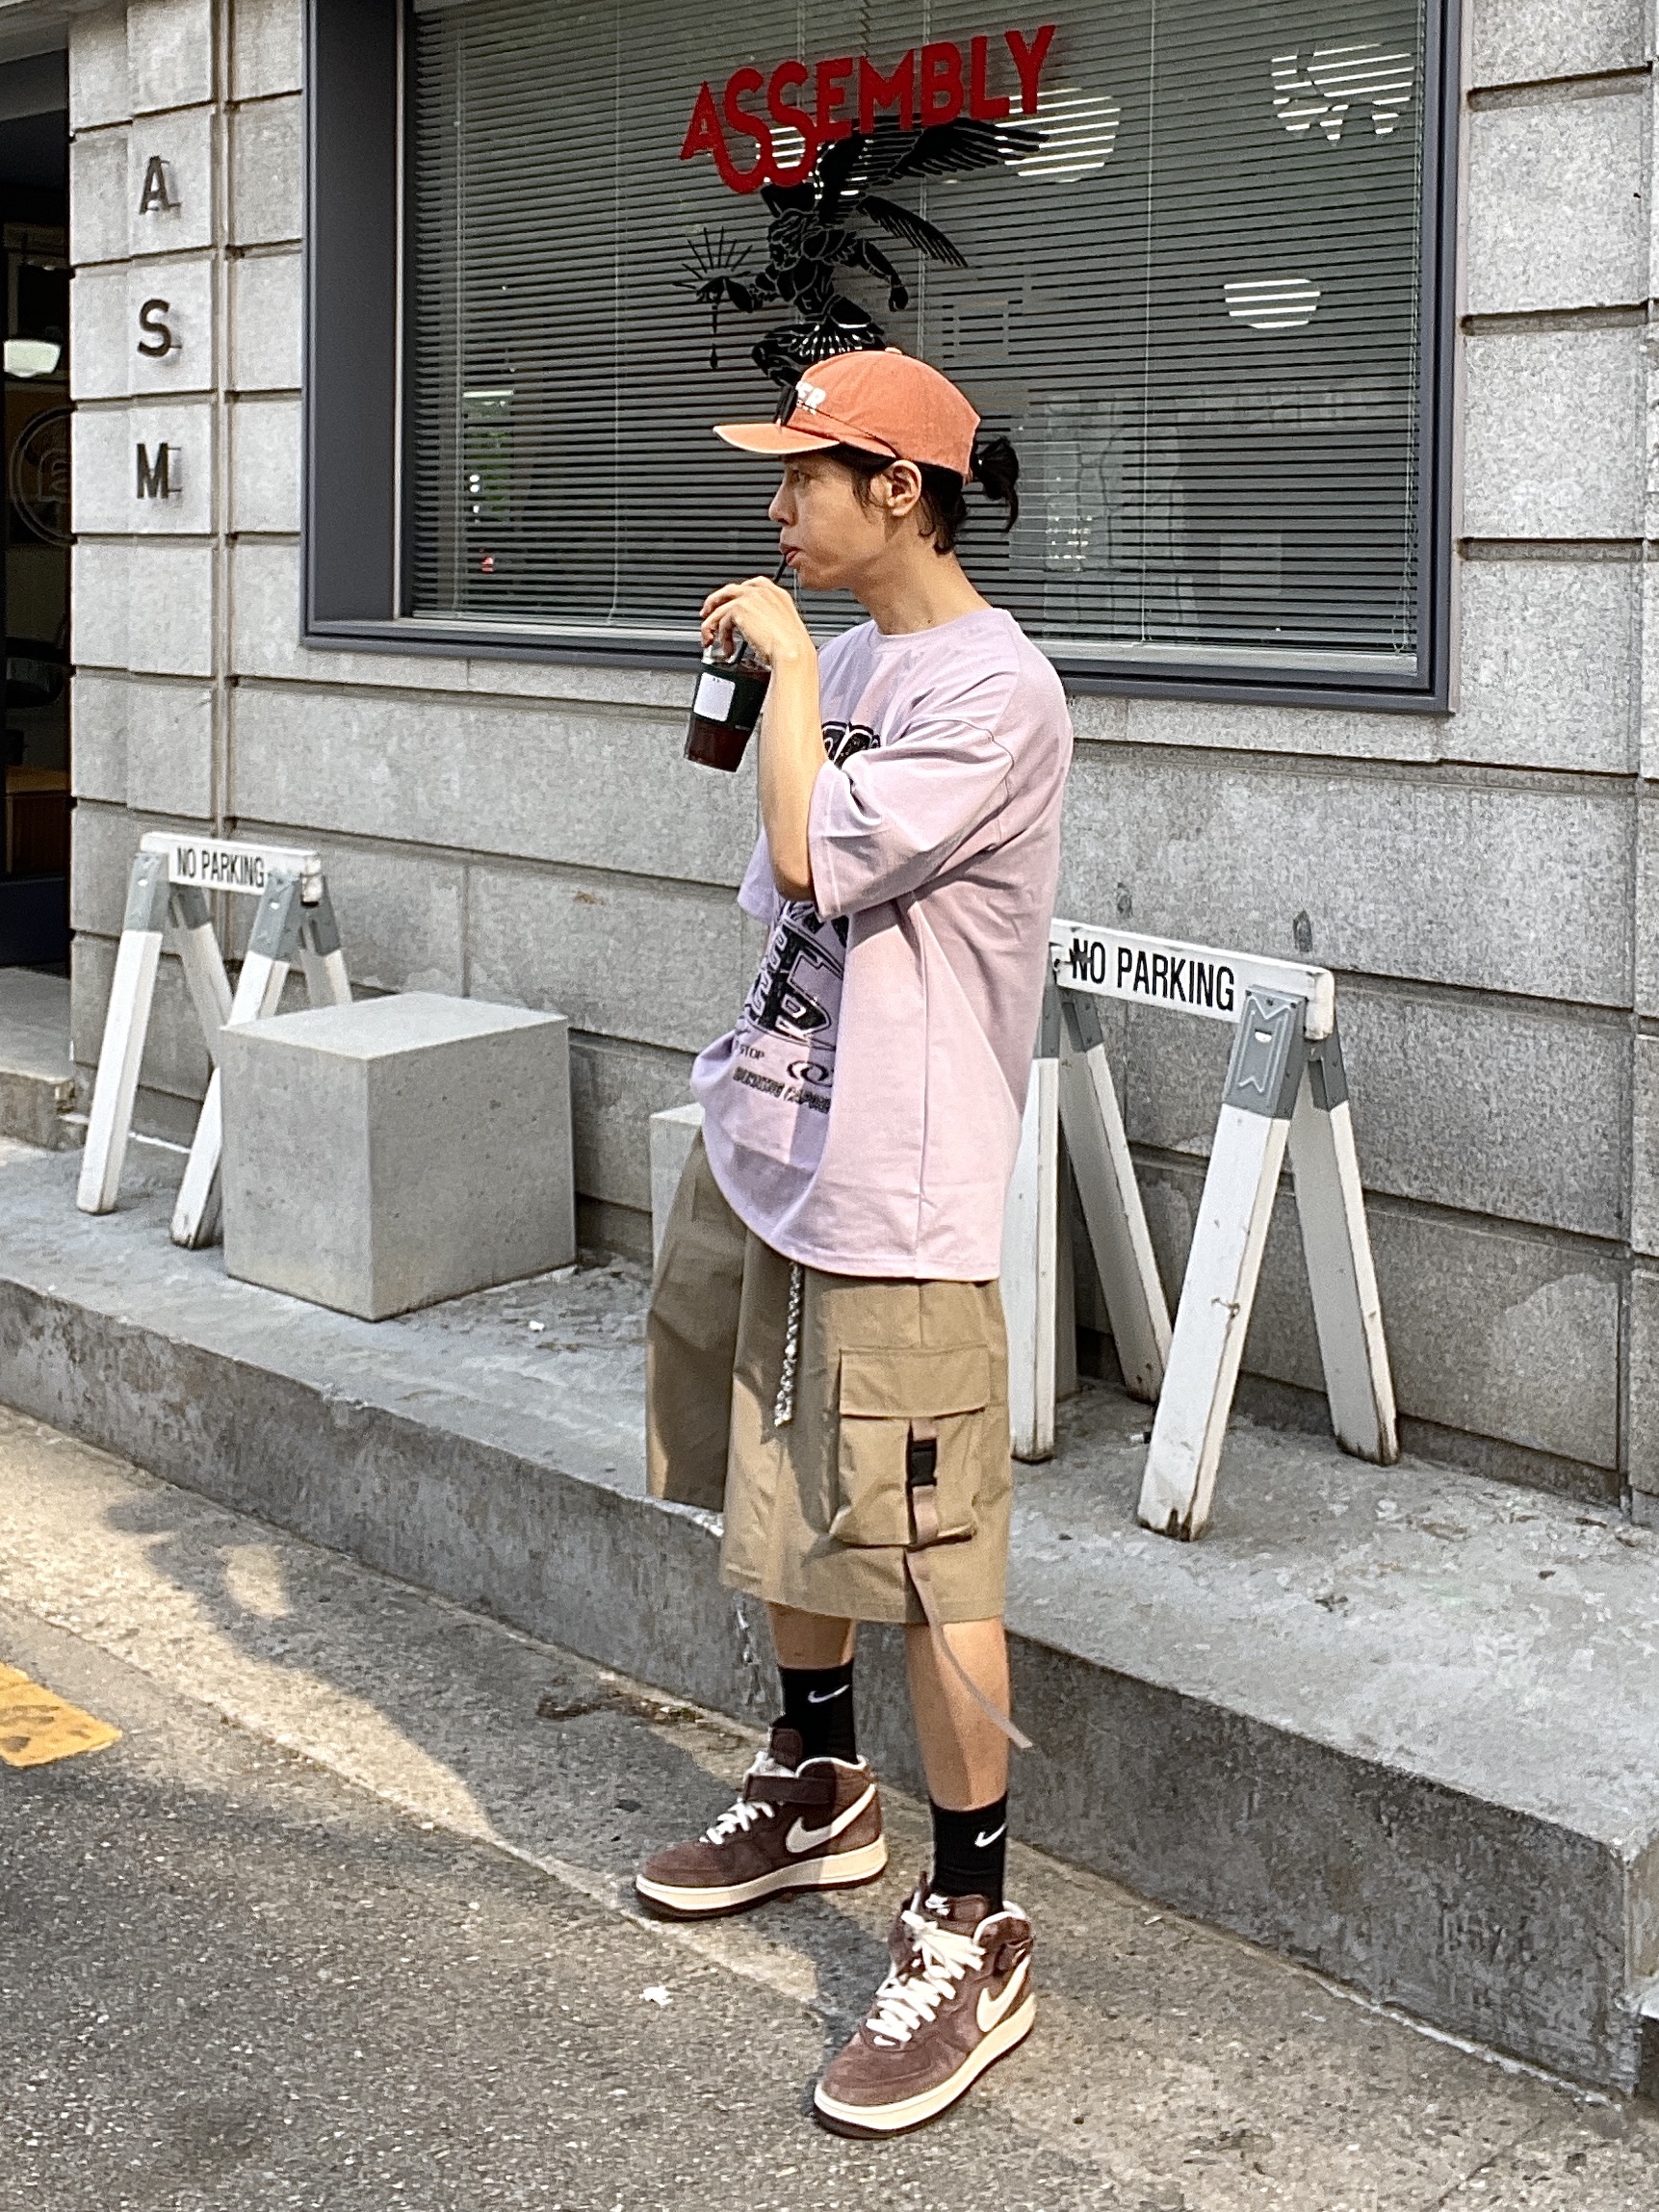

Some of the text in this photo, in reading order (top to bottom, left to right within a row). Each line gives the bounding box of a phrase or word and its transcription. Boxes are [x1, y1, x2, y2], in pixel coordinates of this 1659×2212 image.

[679, 24, 1057, 195] ASSEMBLY
[176, 846, 266, 889] NO PARKING
[1071, 937, 1235, 1012] NO PARKING
